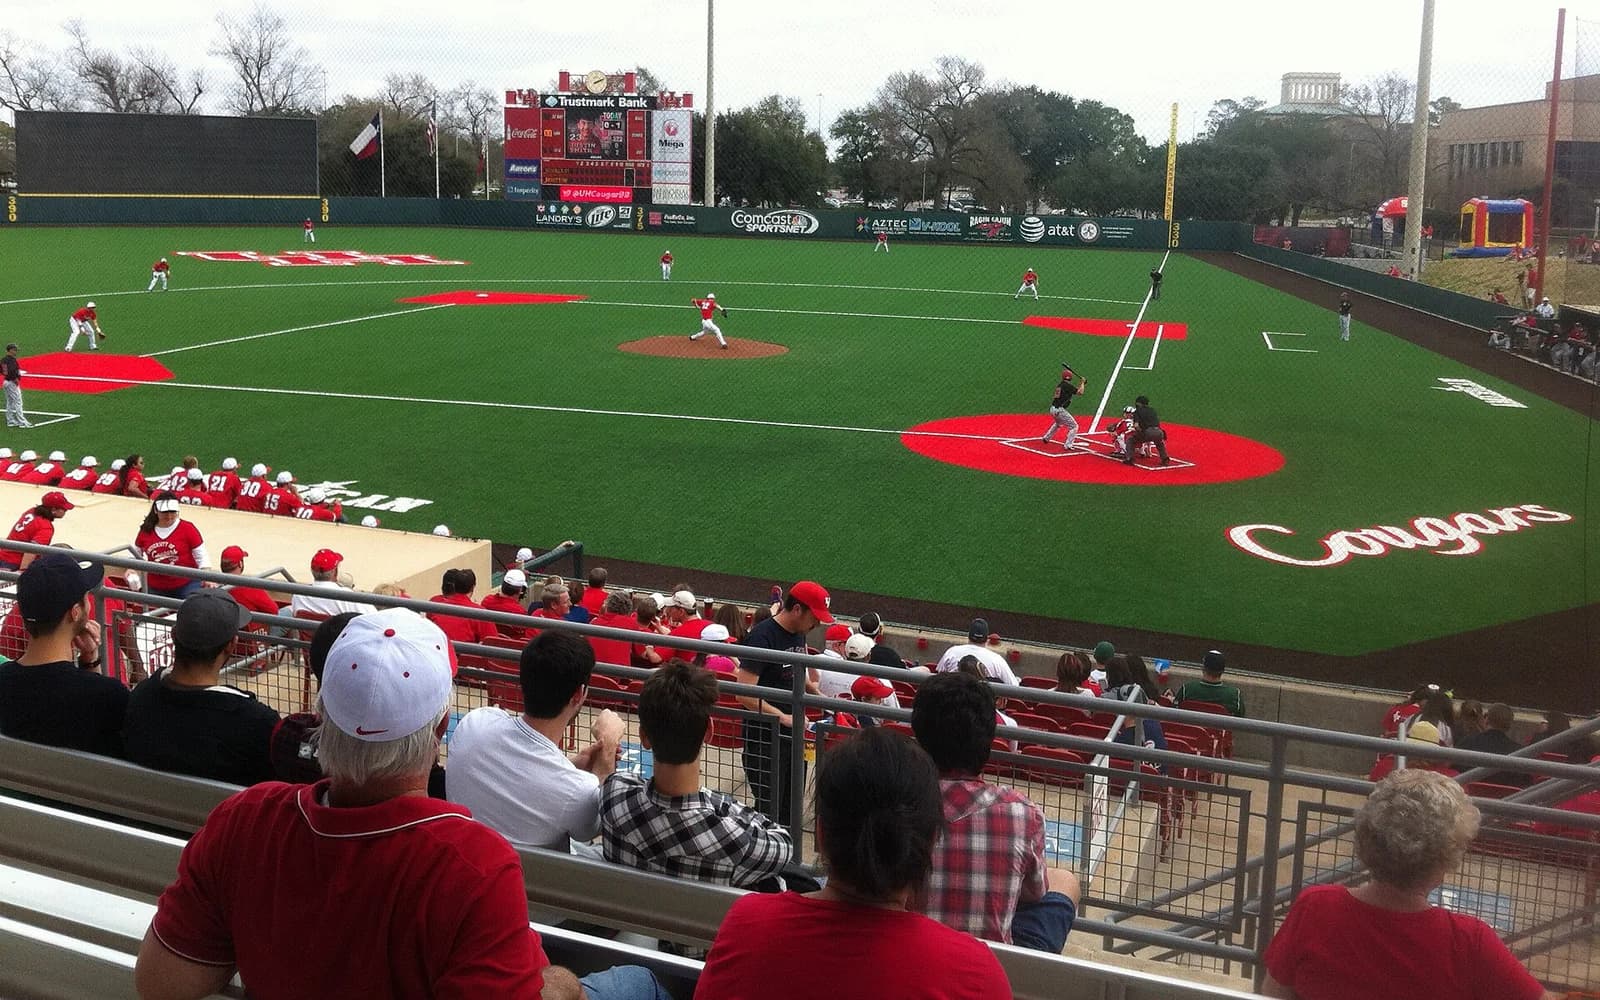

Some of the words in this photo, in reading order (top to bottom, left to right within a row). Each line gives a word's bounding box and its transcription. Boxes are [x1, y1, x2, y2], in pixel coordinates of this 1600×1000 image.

[558, 96, 615, 107] Trustmark
[618, 97, 648, 108] Bank
[569, 133, 581, 141] 23
[536, 215, 582, 223] LANDRY'S
[872, 219, 907, 228] AZTEC
[746, 223, 808, 233] SPORTSNET
[1048, 224, 1075, 236] at&t
[1172, 222, 1180, 248] 330
[211, 475, 227, 491] 21
[241, 481, 261, 497] 30
[265, 493, 280, 510] 15
[1225, 504, 1574, 567] Cougars
